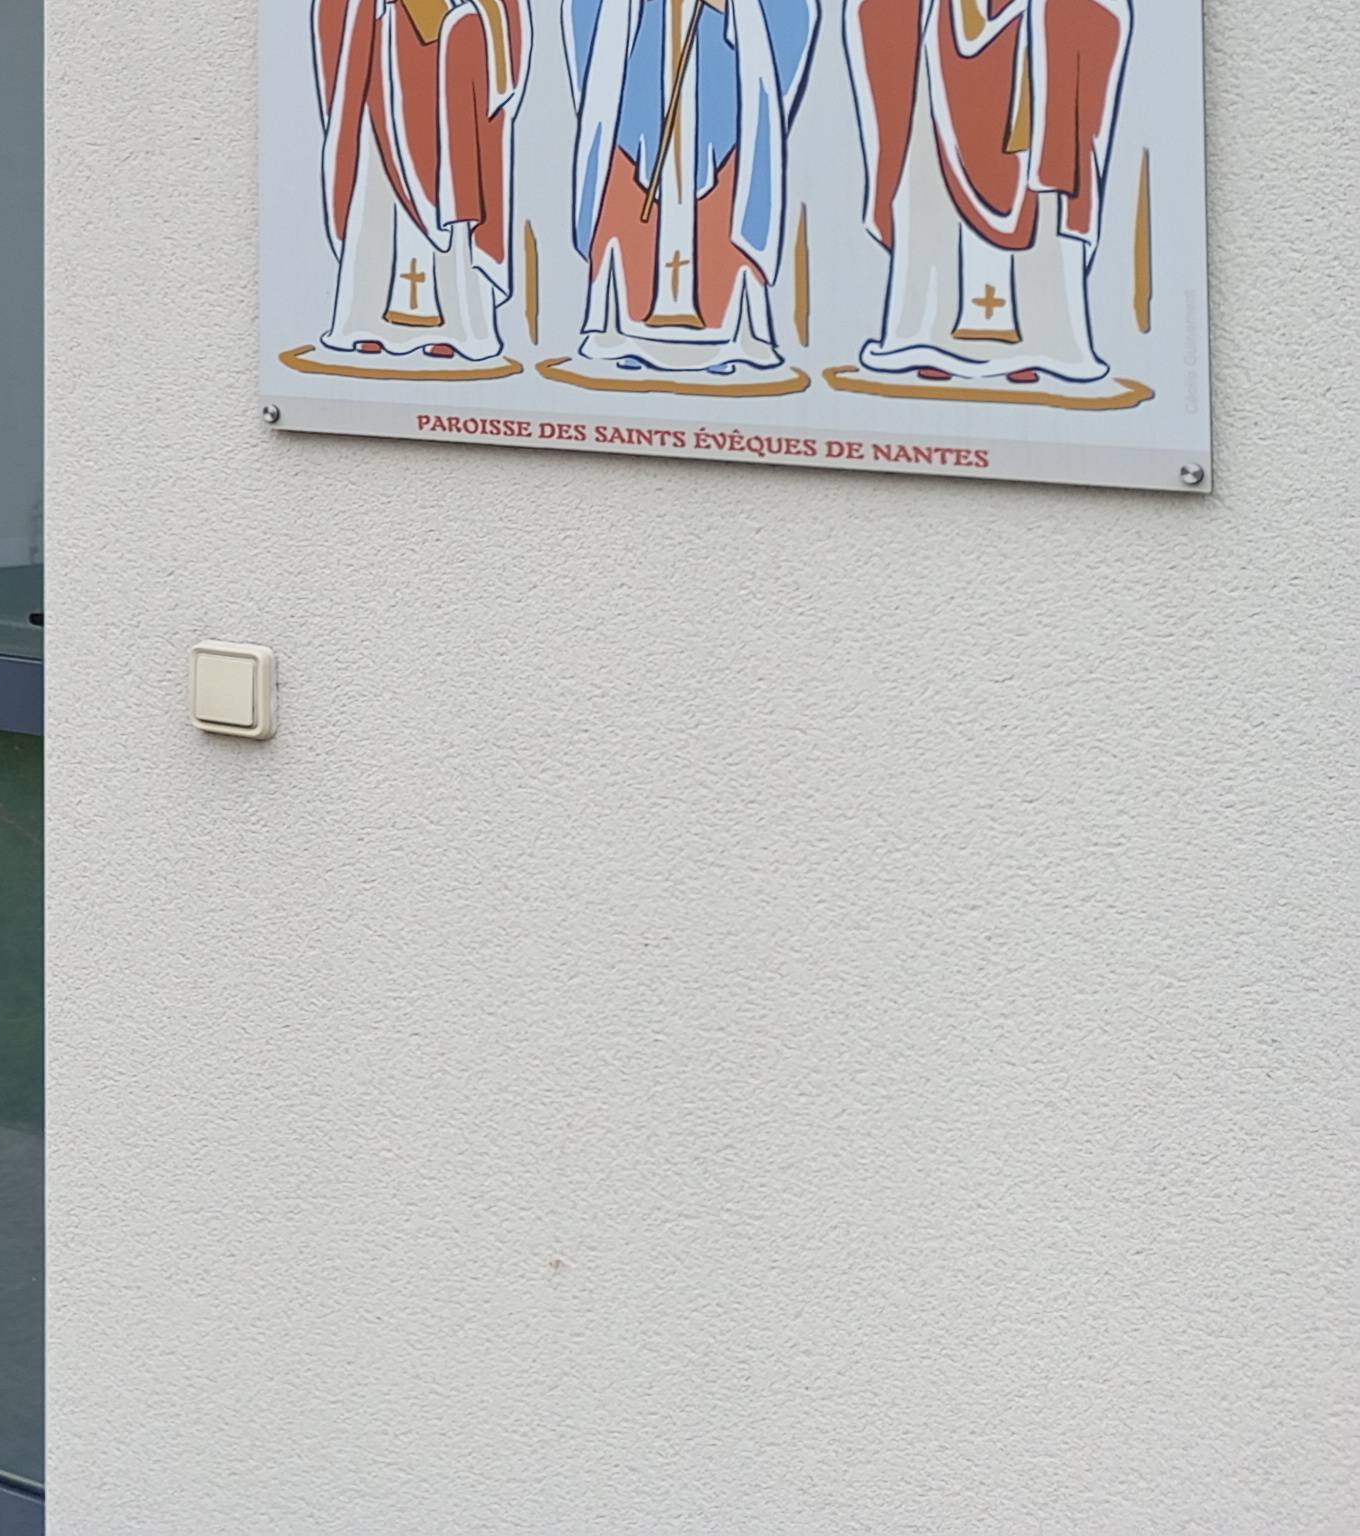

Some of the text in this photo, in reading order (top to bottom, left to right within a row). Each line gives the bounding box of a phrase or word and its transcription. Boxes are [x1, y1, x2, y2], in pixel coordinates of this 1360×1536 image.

[416, 414, 989, 468] PAROISSE DES SAINTS ÉVÊQUES DE NANTES
